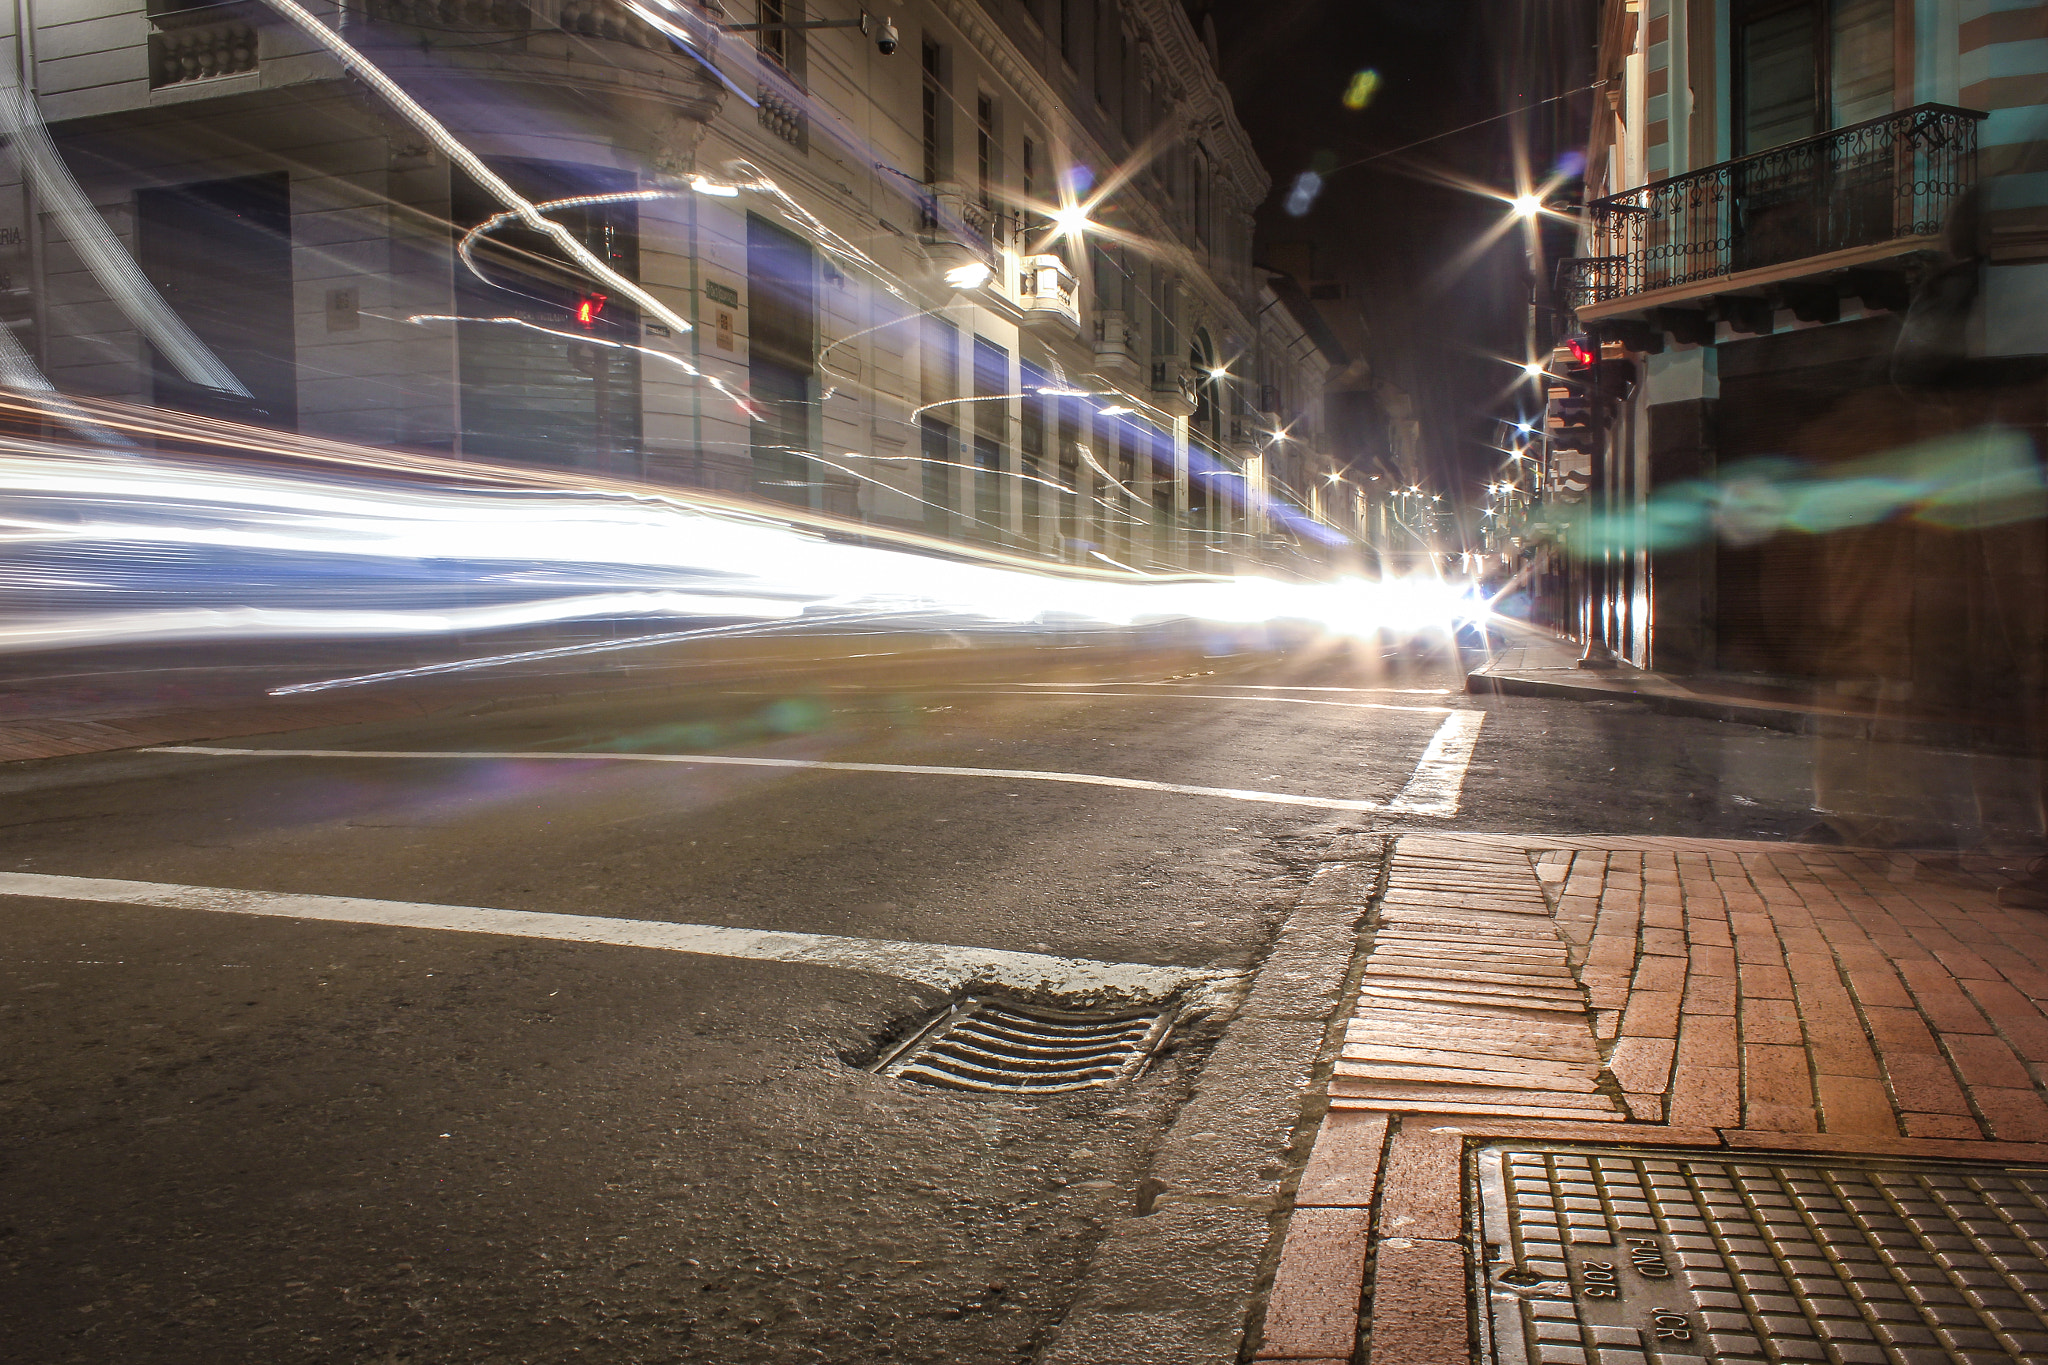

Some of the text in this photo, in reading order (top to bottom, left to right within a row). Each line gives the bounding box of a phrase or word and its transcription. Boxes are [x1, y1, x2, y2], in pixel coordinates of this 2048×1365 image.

[0, 226, 21, 245] RIA
[1582, 1260, 1617, 1298] 2013
[1626, 1237, 1692, 1340] FUND JCR
